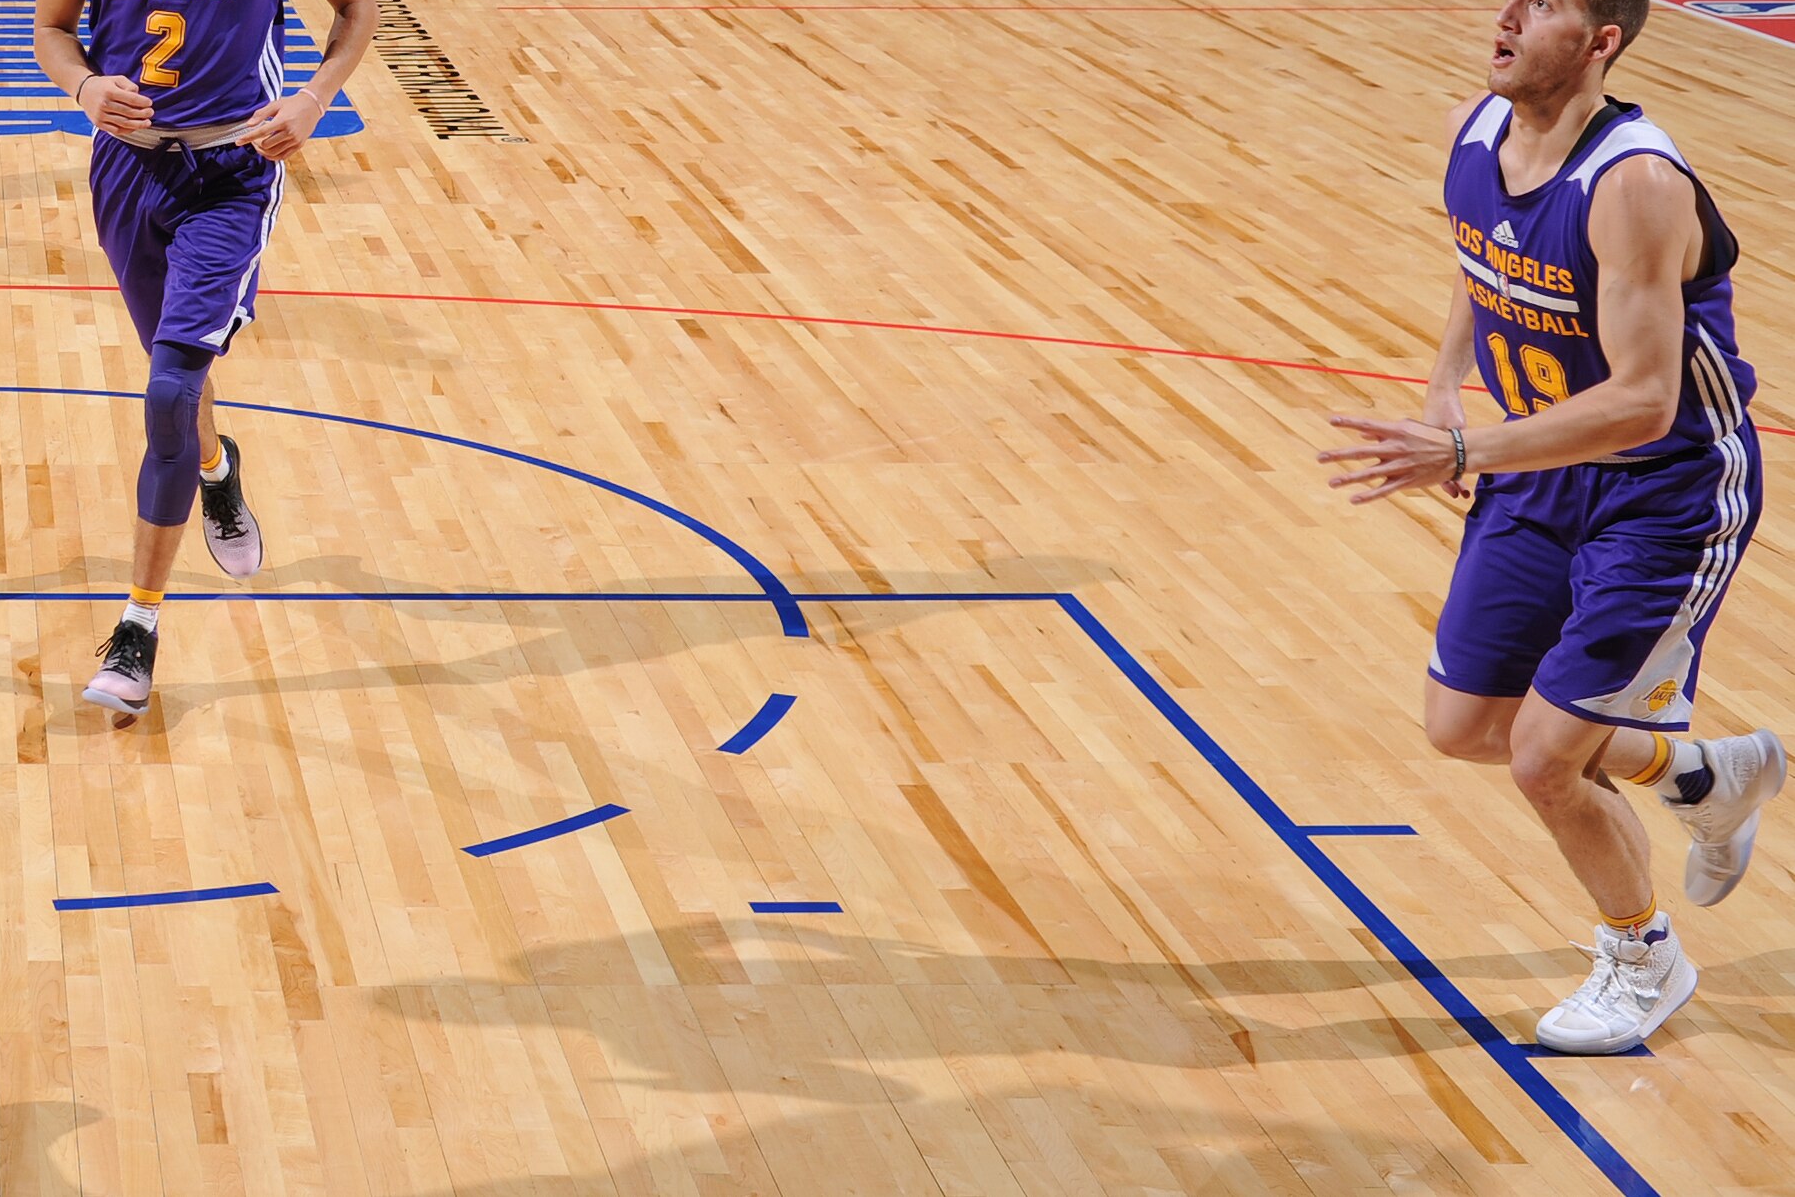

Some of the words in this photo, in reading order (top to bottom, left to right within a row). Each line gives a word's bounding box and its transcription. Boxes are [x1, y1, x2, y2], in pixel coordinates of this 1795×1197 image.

[139, 10, 186, 88] 2
[1452, 215, 1484, 256] LOS
[1485, 240, 1575, 294] ANGELES
[1466, 275, 1590, 338] ASKETBALL
[1487, 331, 1571, 417] 19
